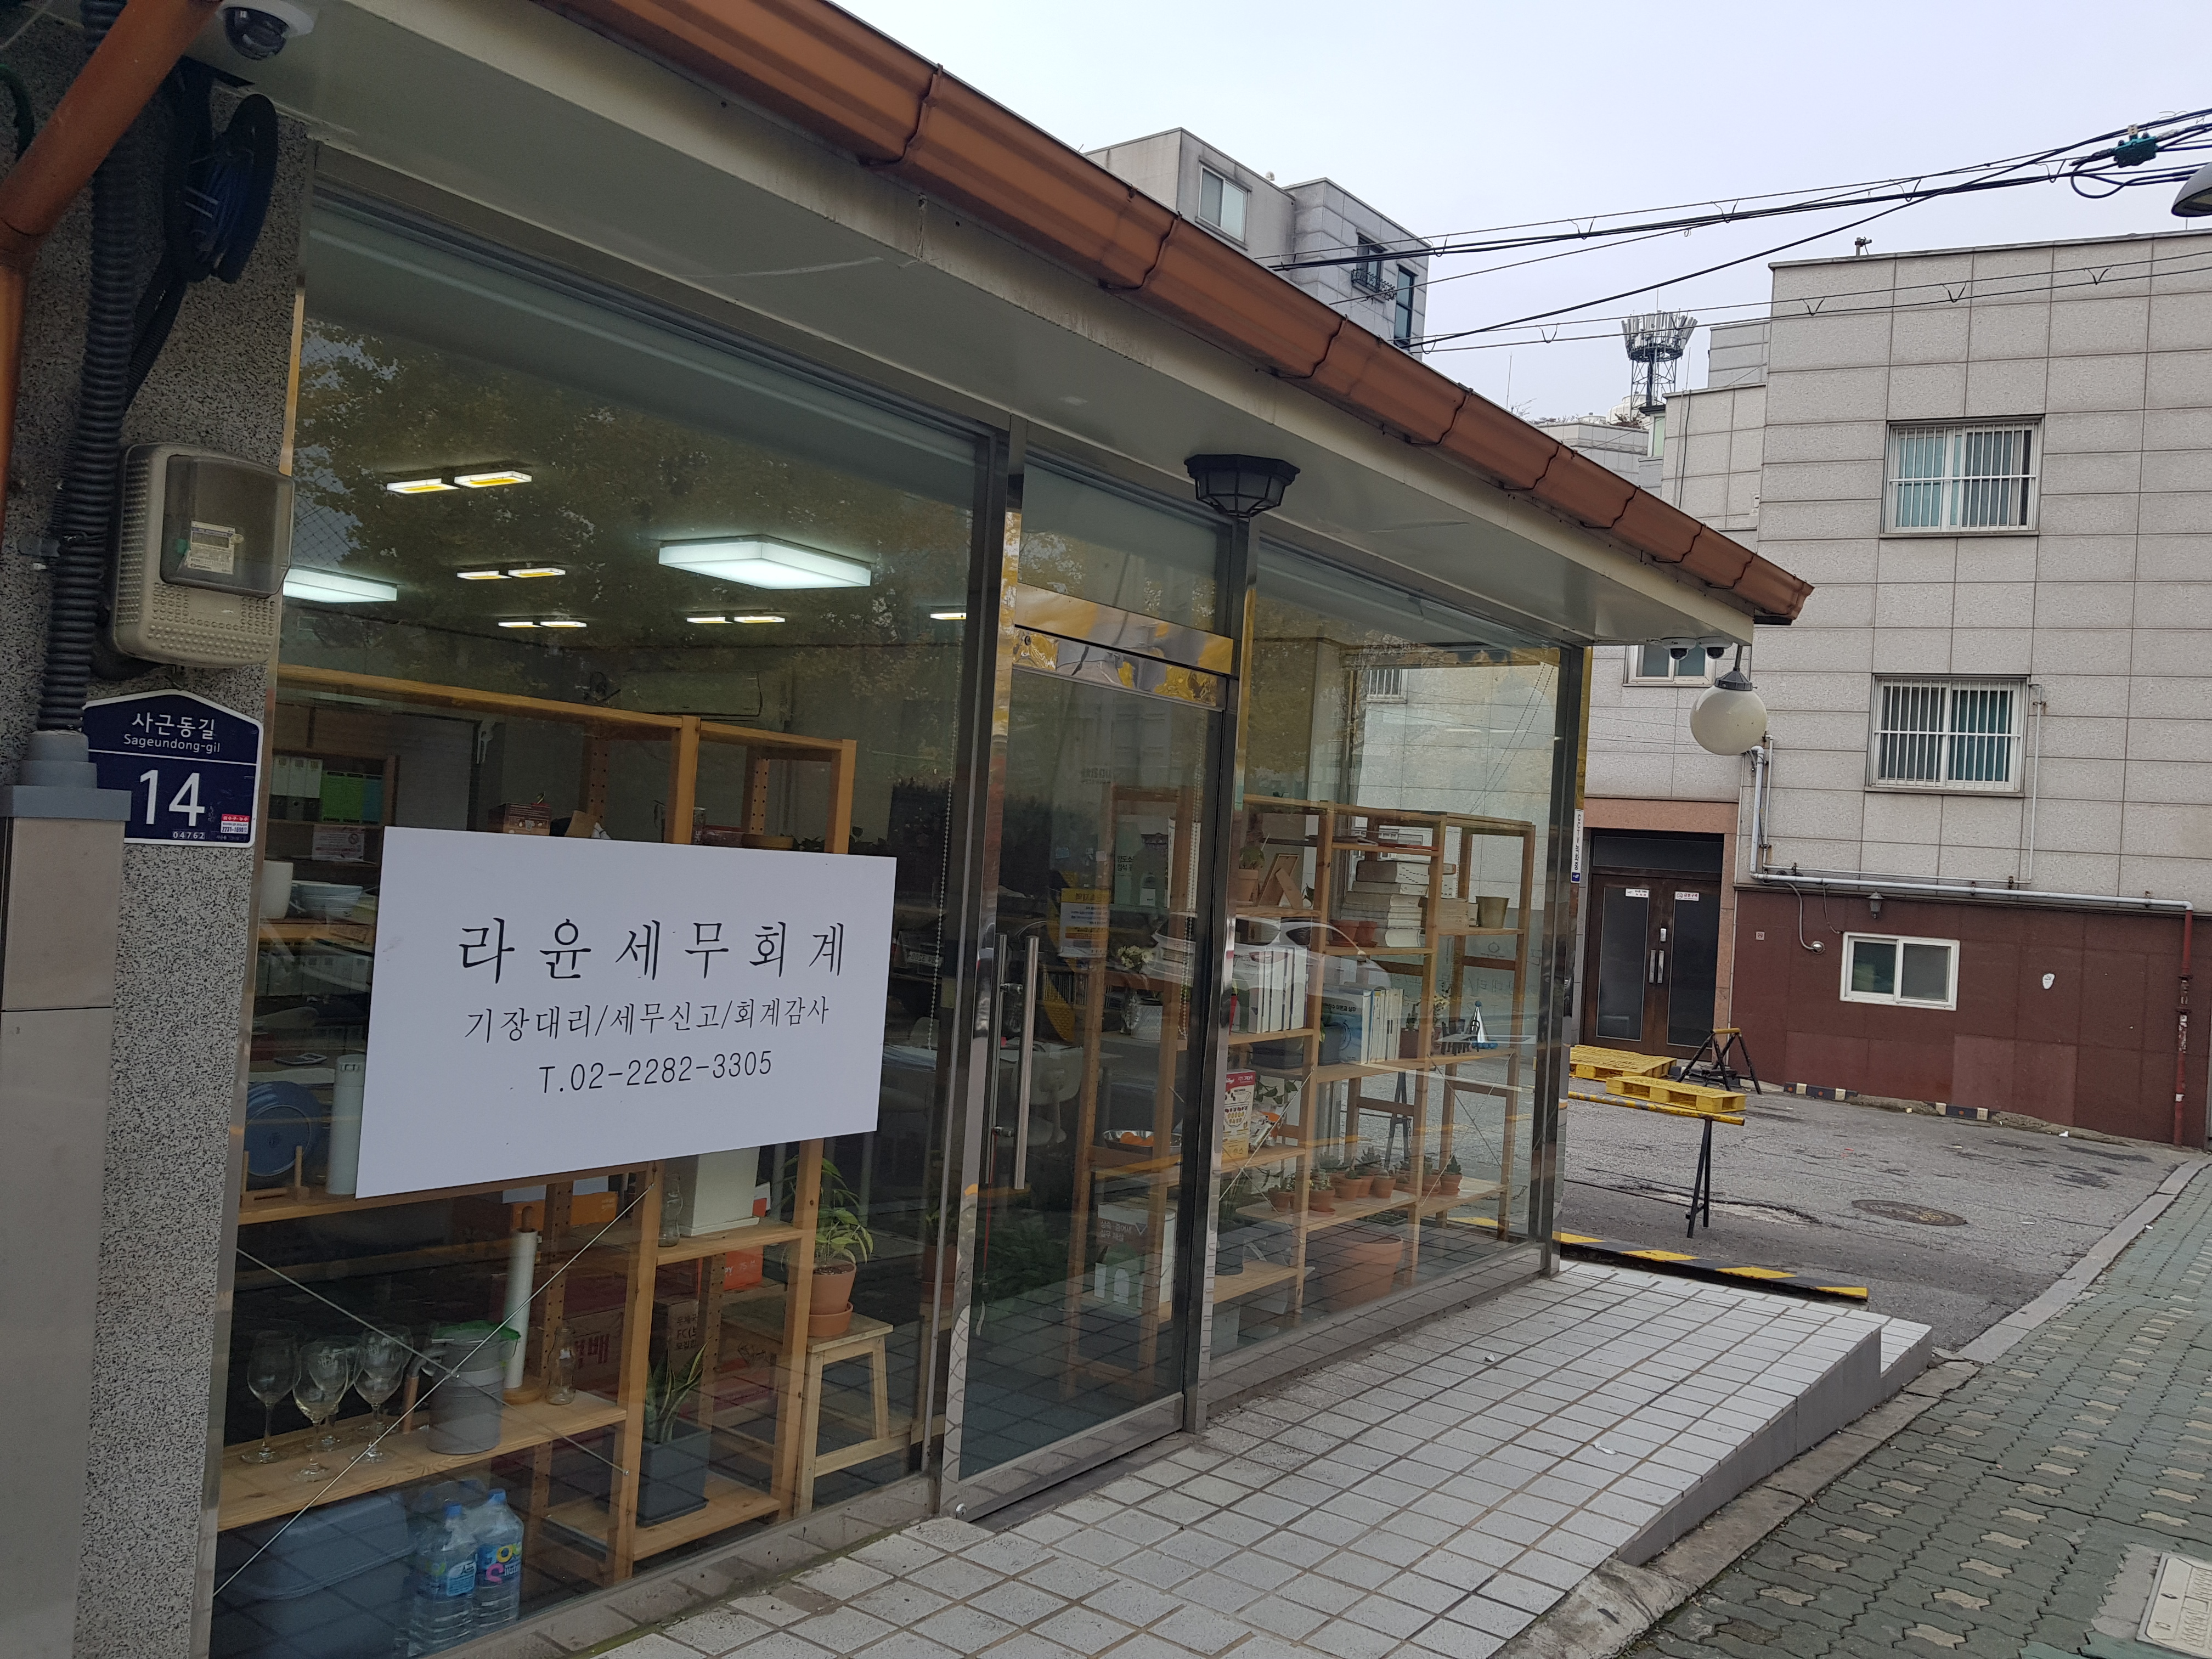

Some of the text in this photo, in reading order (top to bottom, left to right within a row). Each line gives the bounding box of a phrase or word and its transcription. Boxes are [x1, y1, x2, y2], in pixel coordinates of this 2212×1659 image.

[123, 733, 221, 754] Sageundong-gil
[132, 712, 216, 740] 사근동길
[140, 769, 205, 827] 14
[173, 831, 205, 839] 04762
[458, 917, 845, 984] 라윤세무회계
[465, 996, 830, 1043] 기장대리/세무신고/회계감사
[539, 1050, 772, 1094] T.02-2282-3305
